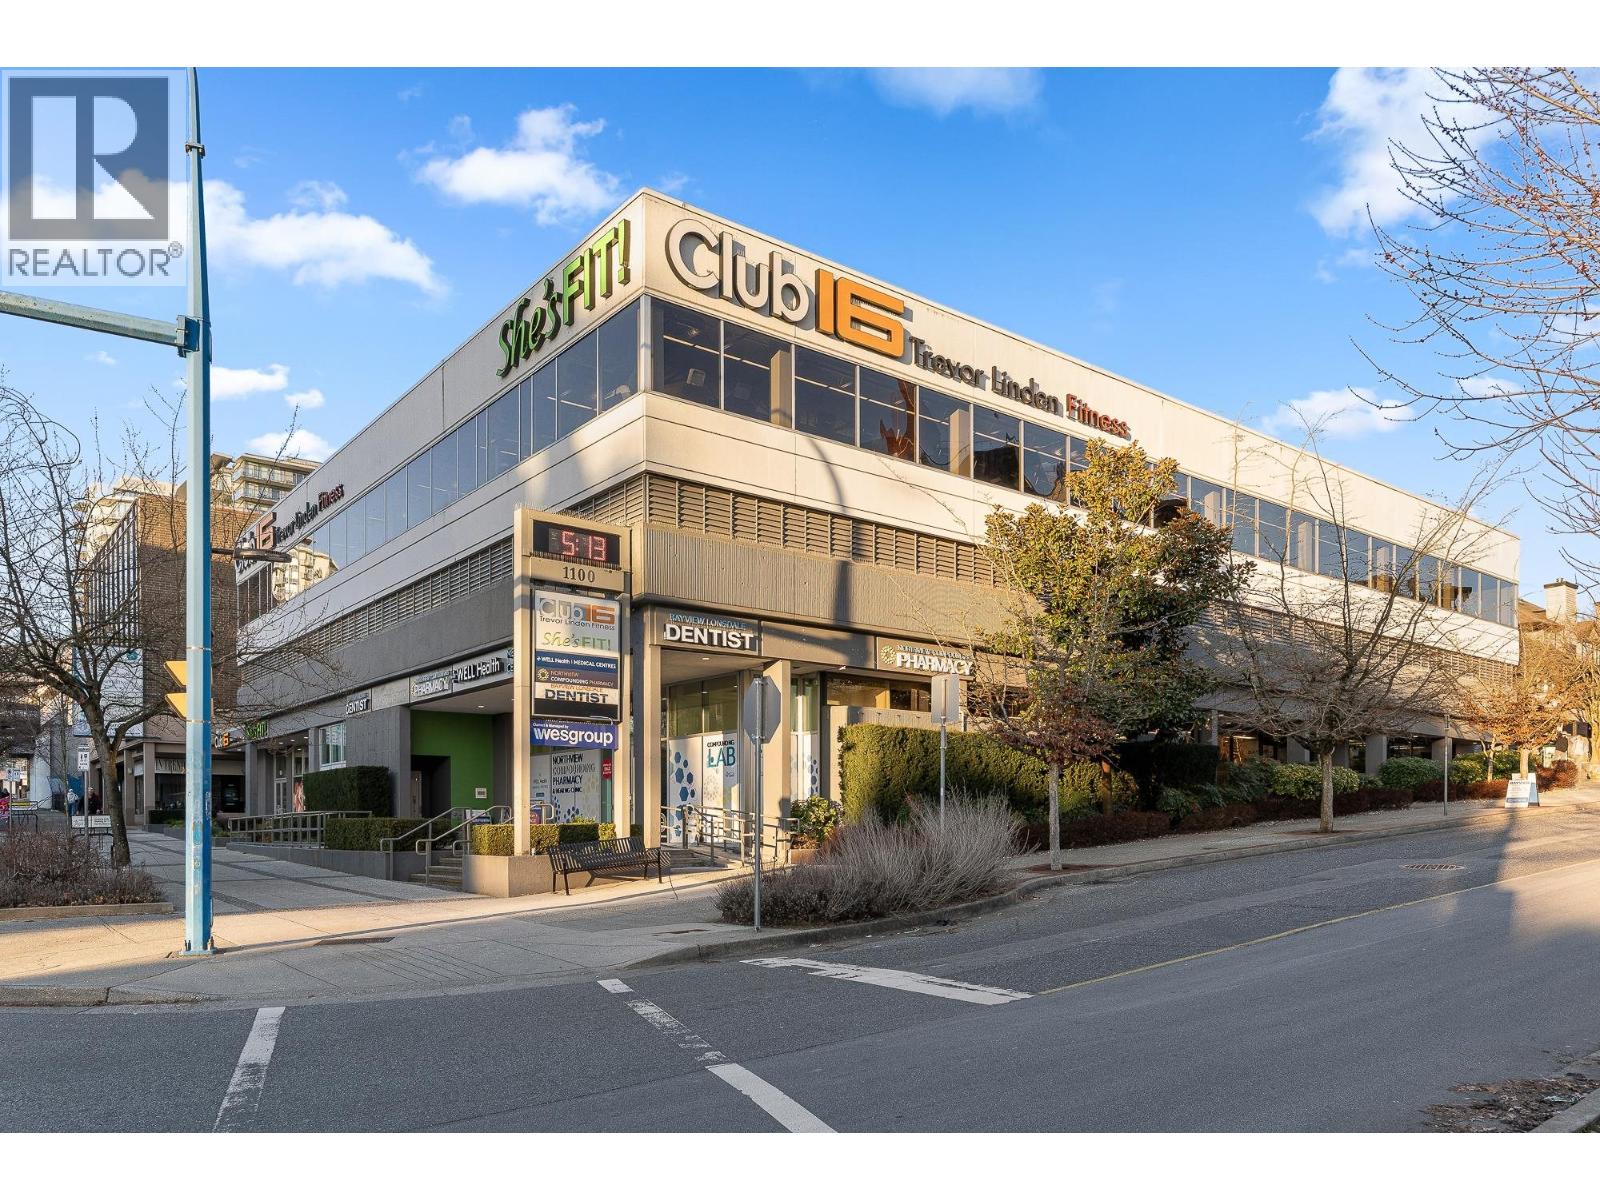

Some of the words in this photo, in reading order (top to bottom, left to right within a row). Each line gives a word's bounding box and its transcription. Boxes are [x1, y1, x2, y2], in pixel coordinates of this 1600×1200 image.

[909, 336, 987, 387] Trevor
[991, 366, 1060, 415] Linden
[1066, 393, 1130, 438] Fitness
[561, 530, 606, 561] 5:13
[562, 566, 596, 583] 1100
[540, 615, 563, 624] Trevor
[565, 618, 591, 628] Linden
[592, 622, 615, 631] Fitness
[669, 613, 705, 625] BAYVIEW
[706, 618, 747, 630] LONSDALE
[664, 623, 754, 649] DENTIST
[457, 664, 476, 681] WELL
[476, 658, 501, 678] Health
[573, 659, 595, 667] MEDICAL
[896, 652, 973, 676] PHARMACY
[550, 676, 589, 685] COMPOUNDING
[545, 689, 609, 703] DENTIST
[346, 699, 368, 714] DENTIST
[534, 728, 614, 746] wesgroup
[553, 753, 583, 765] NORTHVIEW
[707, 746, 736, 768] LAB
[553, 775, 582, 786] PHARMACY
